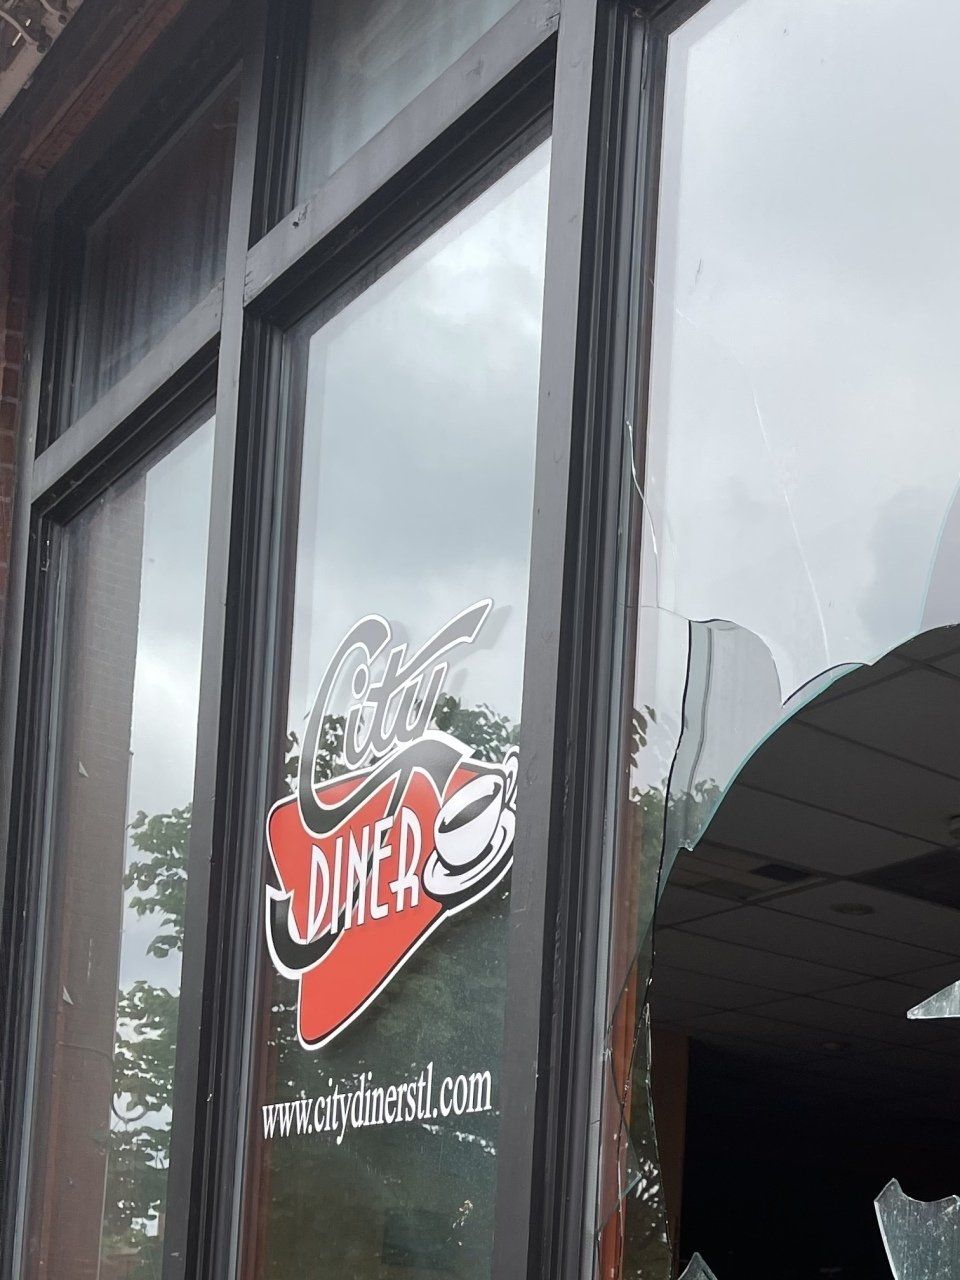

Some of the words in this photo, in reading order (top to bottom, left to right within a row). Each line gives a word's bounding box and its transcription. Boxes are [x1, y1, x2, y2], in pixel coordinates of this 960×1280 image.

[299, 598, 493, 837] City
[306, 807, 421, 936] DINER
[262, 1062, 493, 1146] www.citydinerstl.com
